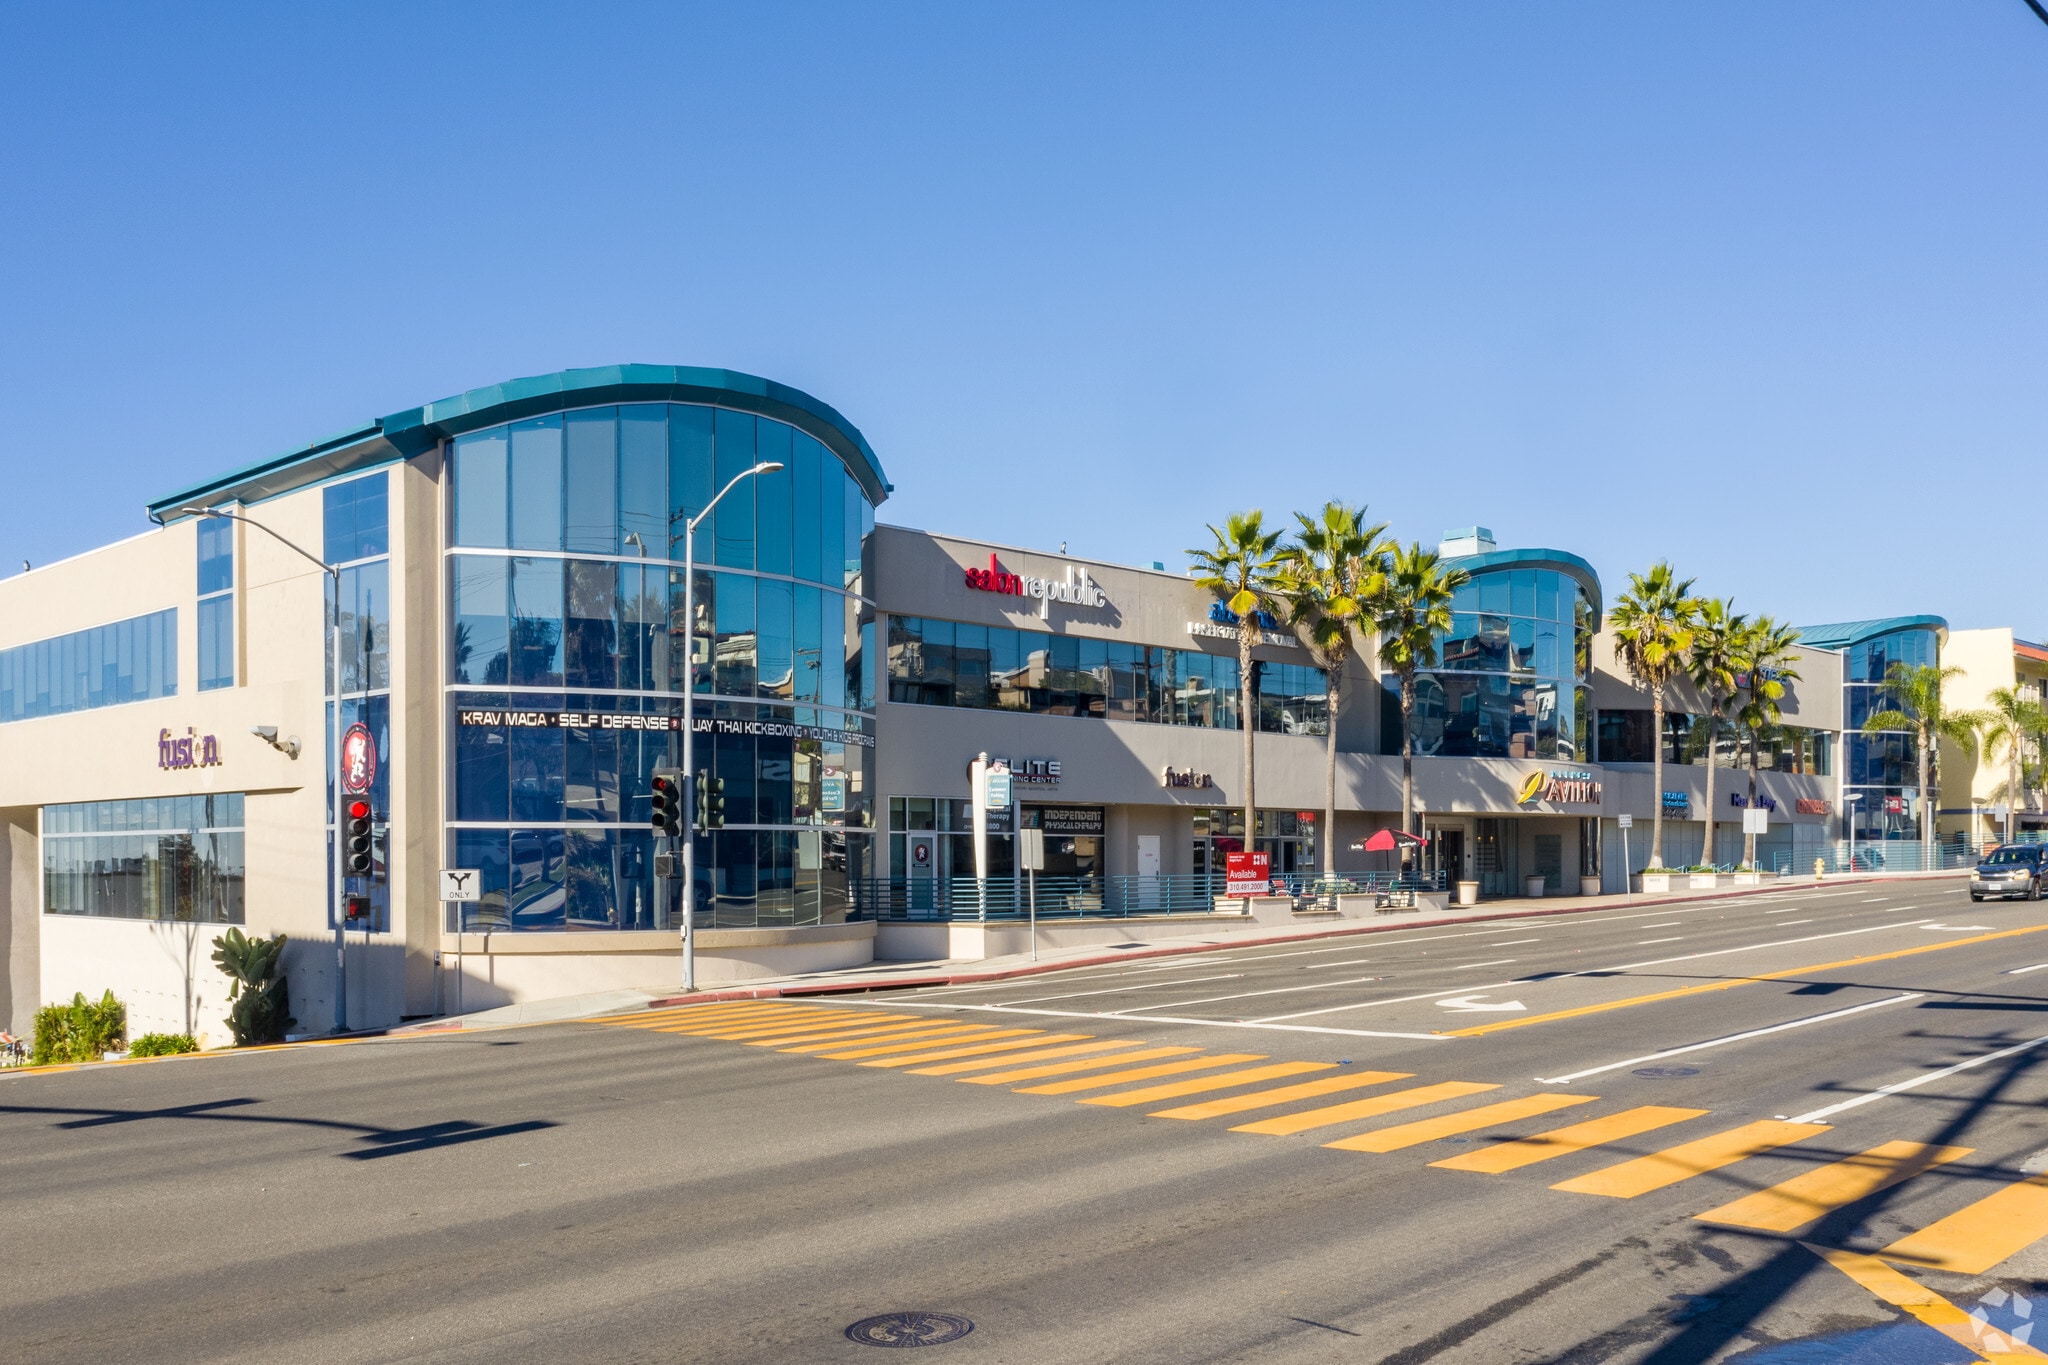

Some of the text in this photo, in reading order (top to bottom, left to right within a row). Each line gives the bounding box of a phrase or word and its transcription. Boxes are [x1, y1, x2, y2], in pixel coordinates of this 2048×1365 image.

[1261, 632, 1298, 648] EMOVAL
[463, 711, 502, 726] KRAV
[505, 712, 547, 727] MAGA
[559, 713, 598, 727] SELF
[601, 715, 669, 730] DEFENSE
[717, 720, 743, 733] THAI
[744, 721, 803, 738] KICKBOXING
[809, 729, 833, 741] YOUTH
[839, 731, 852, 743] KIDS
[158, 726, 219, 768] fusion
[1031, 776, 1061, 784] CENTER
[1162, 766, 1213, 788] fusion
[1230, 869, 1257, 879] Available
[449, 891, 471, 899] ONLY
